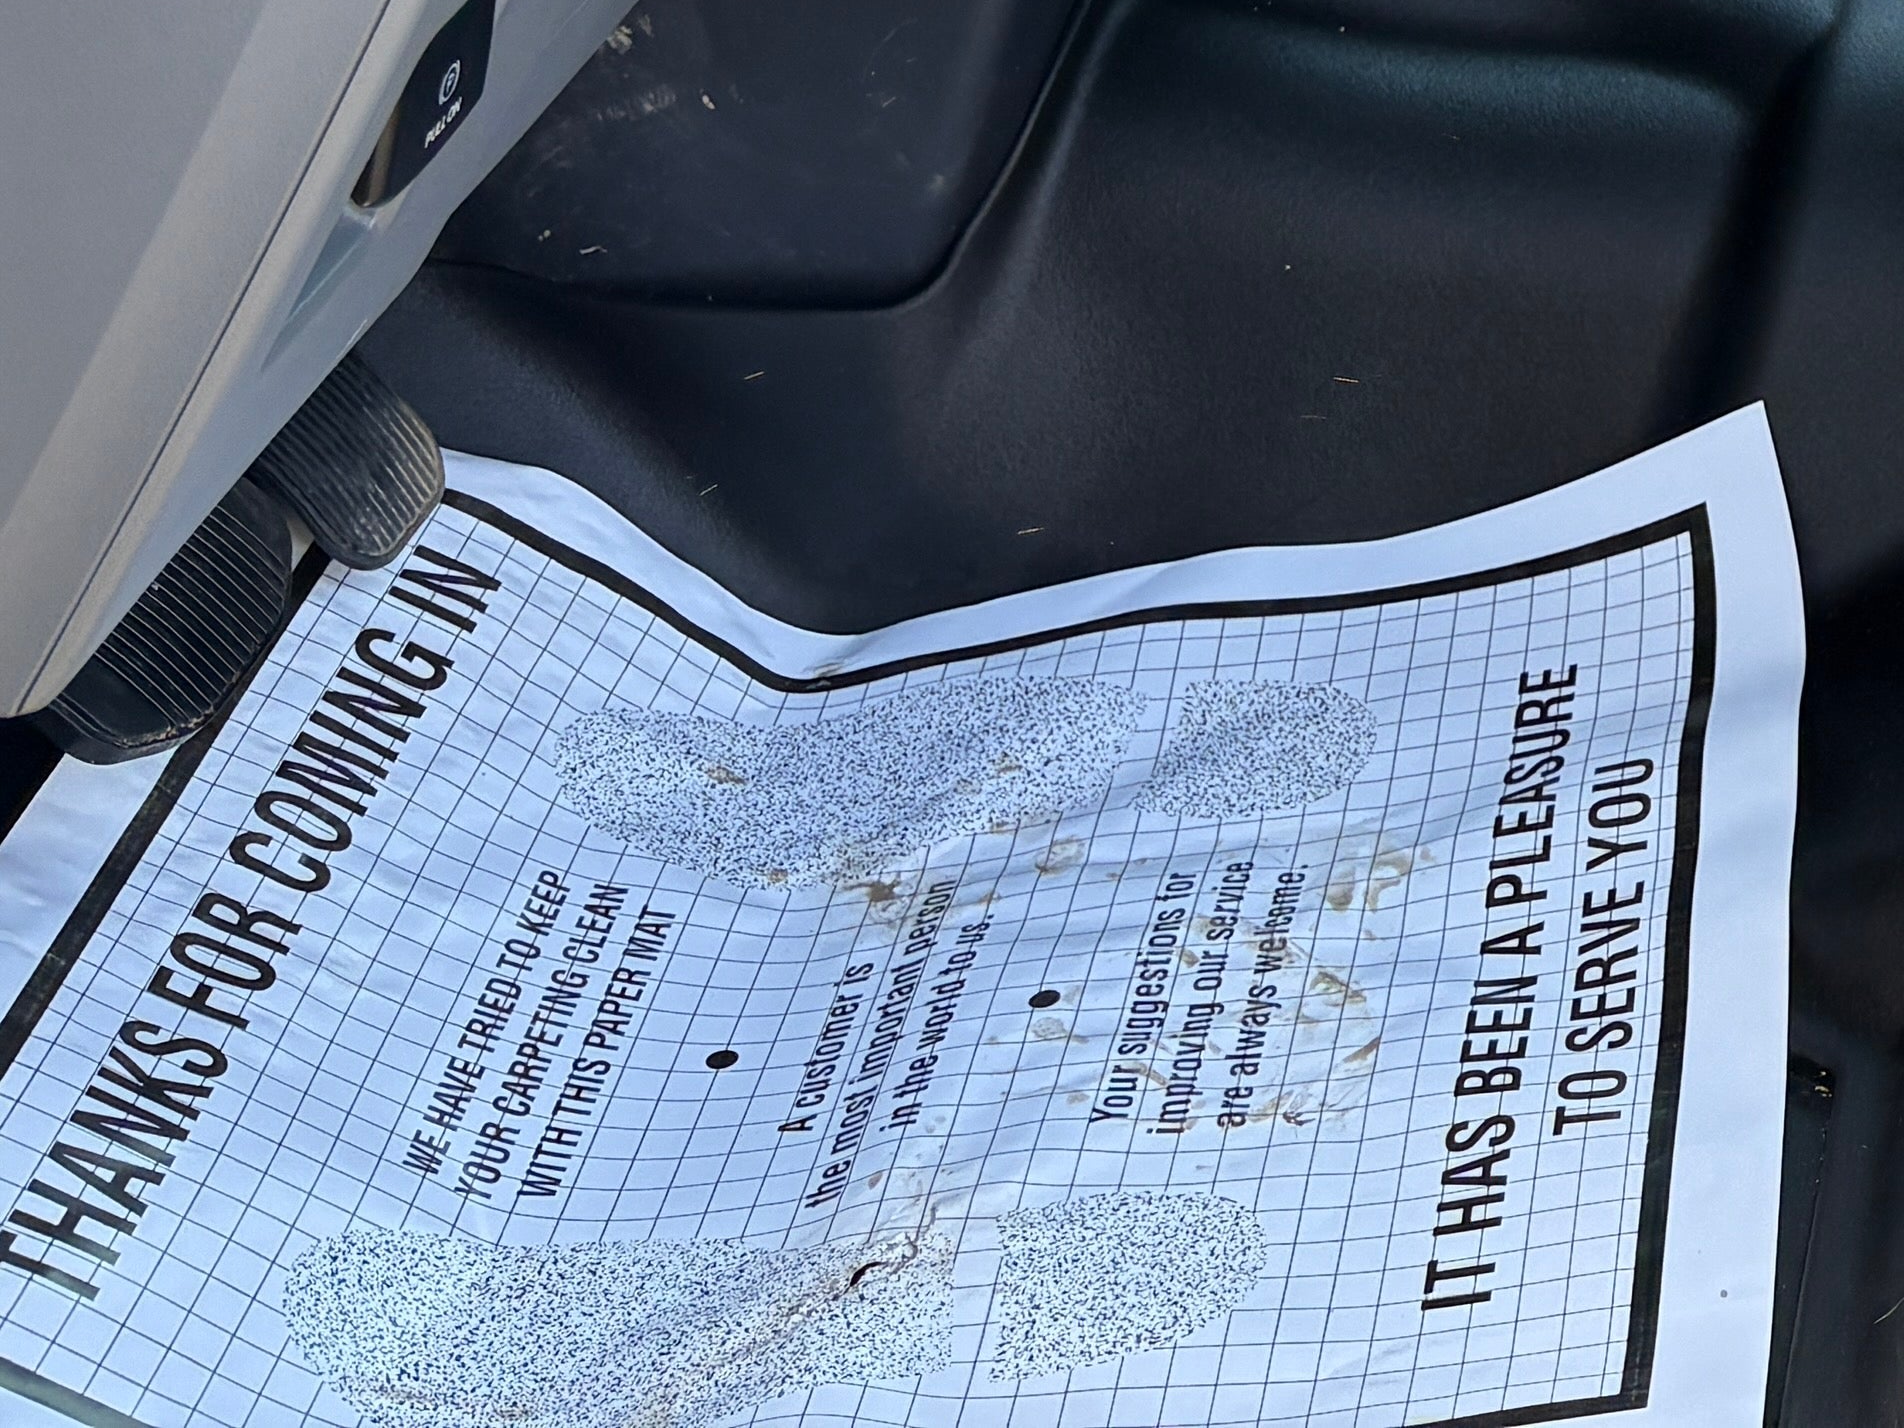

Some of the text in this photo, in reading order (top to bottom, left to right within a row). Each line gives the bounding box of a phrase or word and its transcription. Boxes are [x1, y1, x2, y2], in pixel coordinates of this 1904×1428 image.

[424, 96, 463, 149] PULL ON
[0, 544, 502, 1302] THANKS FOR COMING IN
[402, 870, 571, 1175] WE HAVE TRIED TO KEEP
[454, 884, 630, 1200] YOUR CARPETING CLEAN
[517, 904, 677, 1198] WITH THIS PAPER MAT
[777, 961, 875, 1132] A customer is
[805, 880, 957, 1209] the most important person
[879, 913, 995, 1132] in the world to us.
[1088, 872, 1197, 1124] Your suggestions for
[1146, 860, 1254, 1135] improving our service
[1224, 984, 1283, 1076] always
[1421, 663, 1578, 1311] IT HAS BEEN A PLEASURE
[1552, 758, 1655, 1136] TO SERVE YOU
[1216, 1085, 1254, 1129] are
